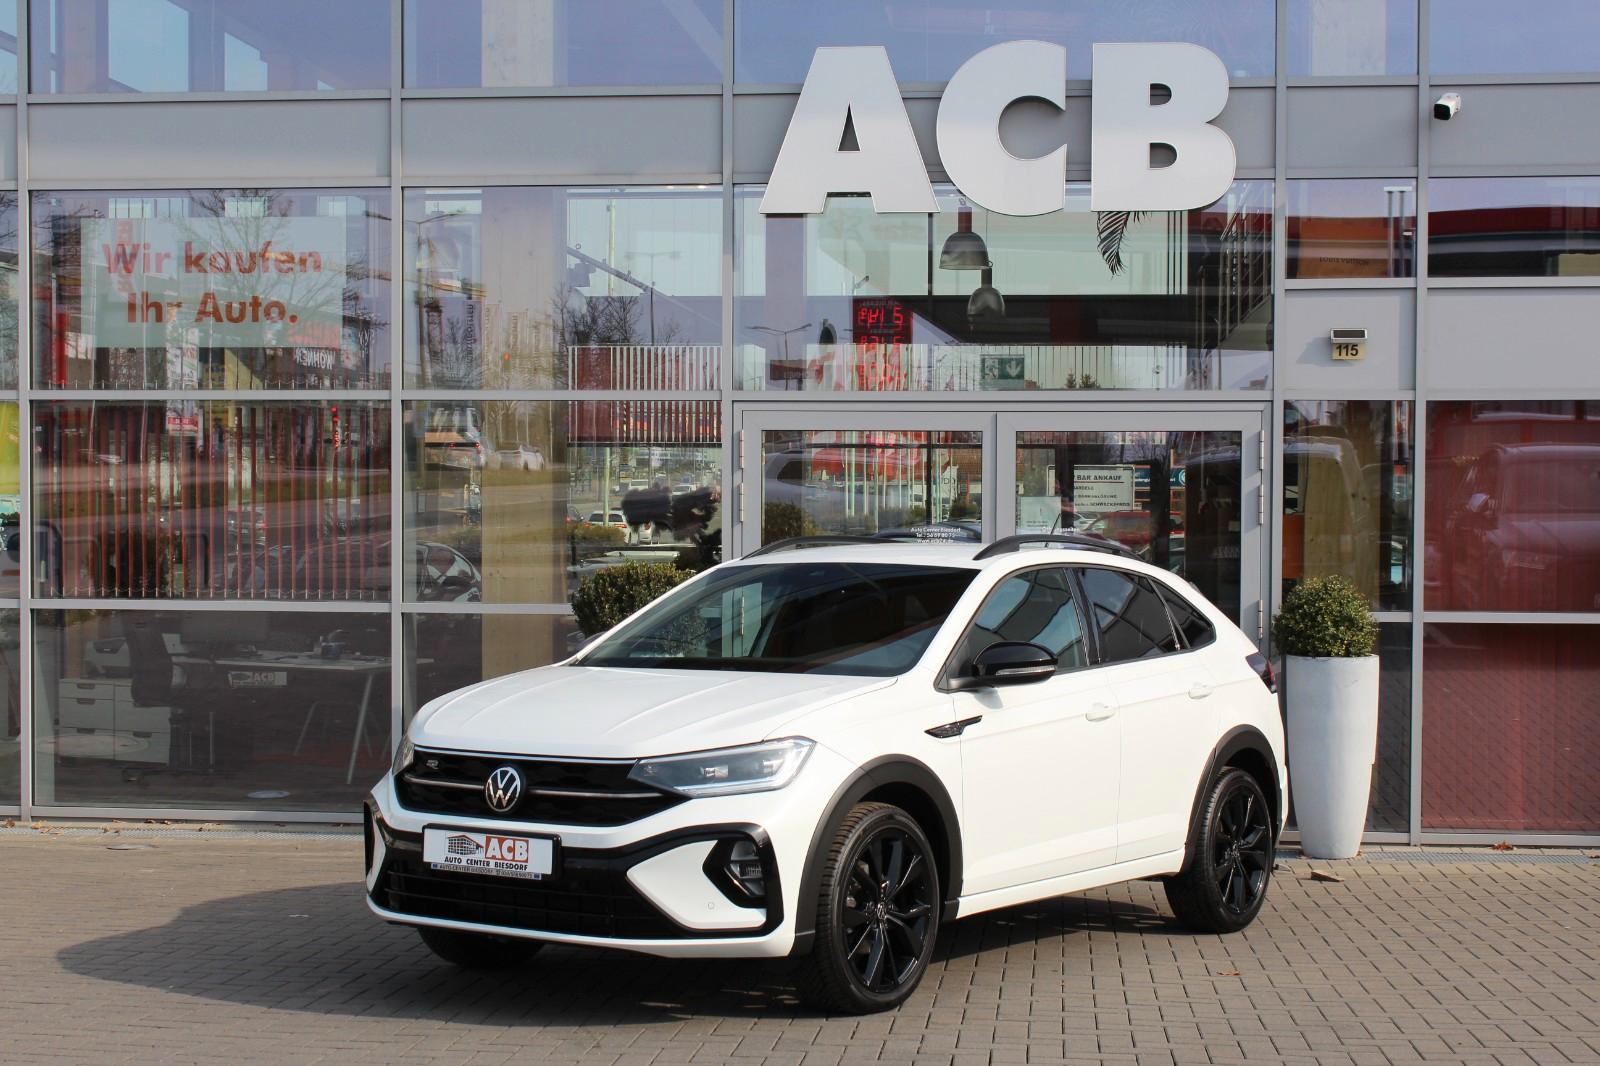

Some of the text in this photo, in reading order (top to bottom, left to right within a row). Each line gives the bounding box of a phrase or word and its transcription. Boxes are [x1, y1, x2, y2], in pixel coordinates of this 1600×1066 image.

[760, 39, 1237, 217] ACB
[102, 241, 322, 274] Wir kaufen
[127, 291, 299, 324] Ihr Auto.
[1335, 344, 1359, 357] 115
[485, 837, 529, 861] ACB
[444, 856, 529, 871] AUTO CENTER BIESDORF
